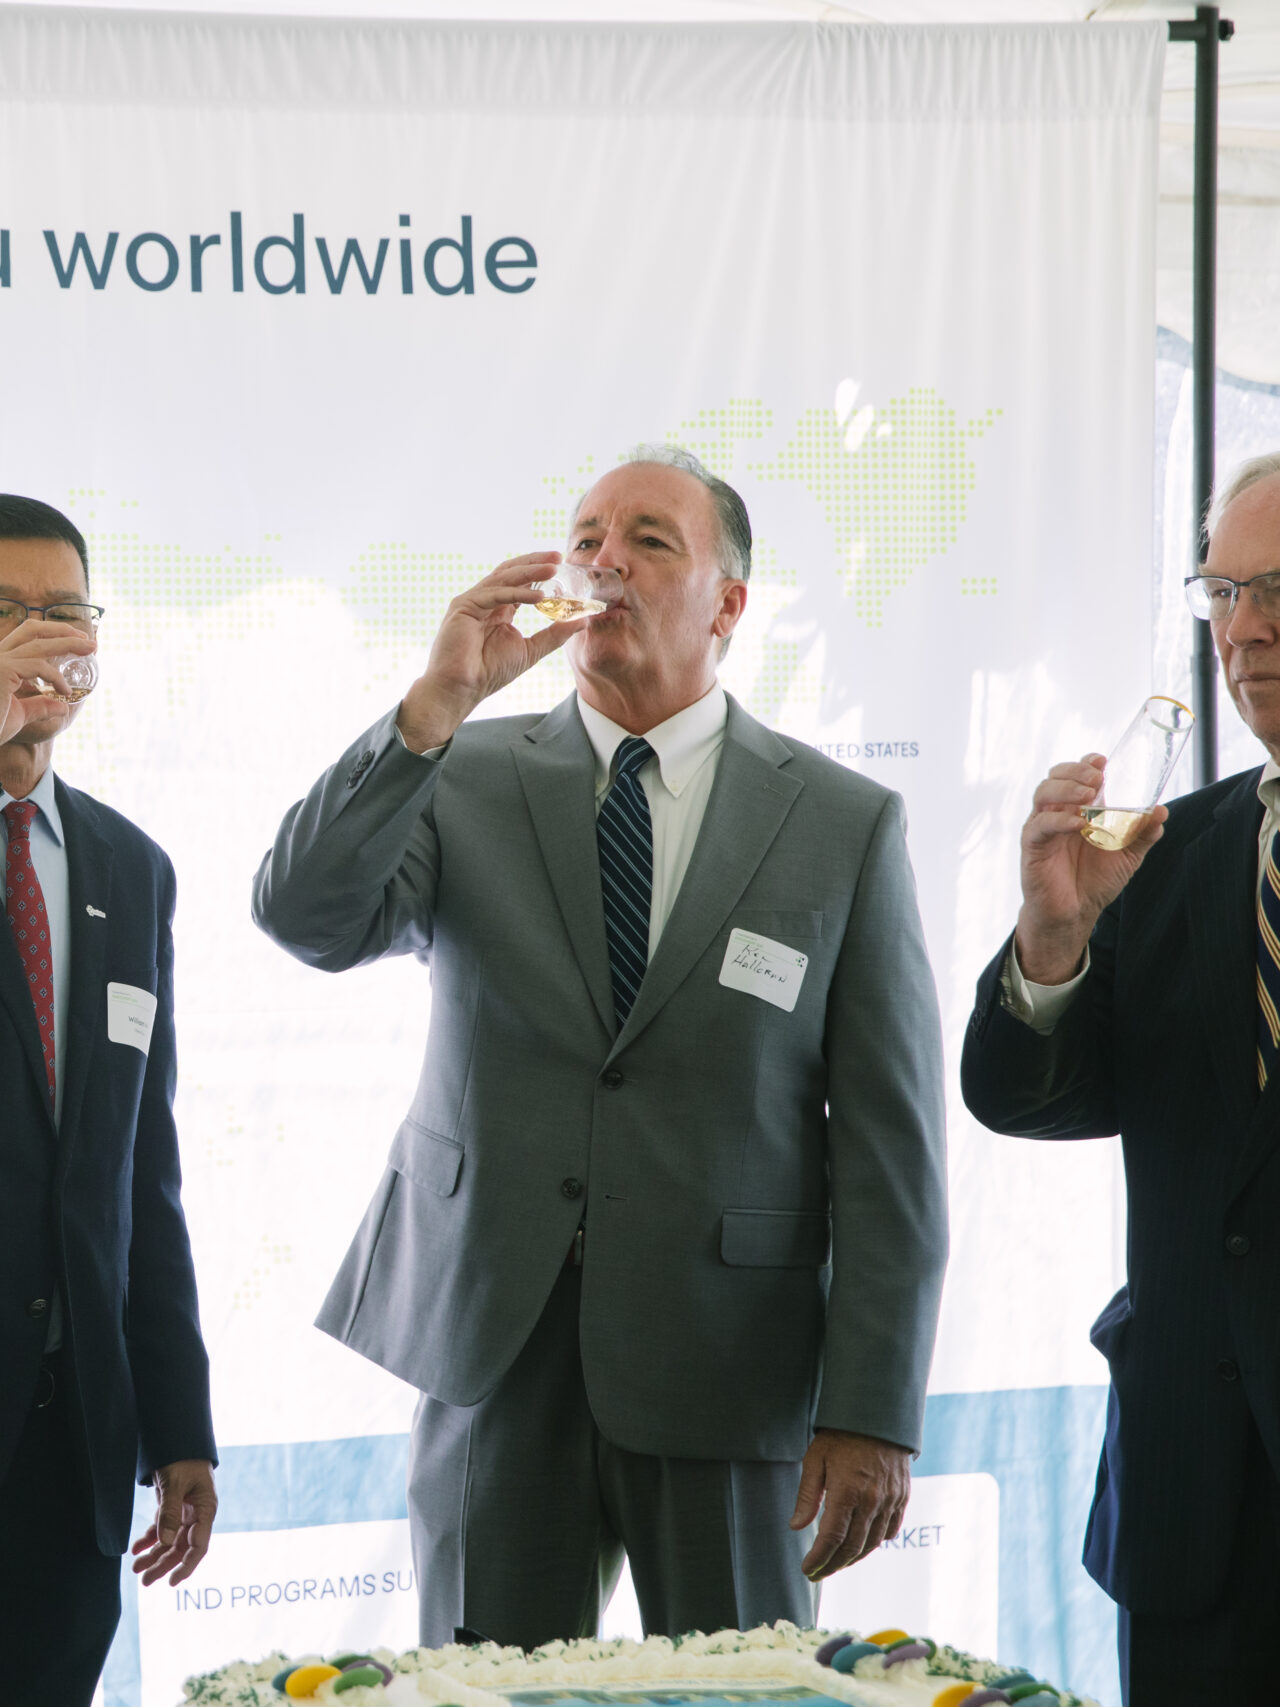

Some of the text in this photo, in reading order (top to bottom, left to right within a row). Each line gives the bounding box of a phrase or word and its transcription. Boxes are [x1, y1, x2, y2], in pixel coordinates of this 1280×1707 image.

[43, 211, 537, 296] worldwide
[814, 741, 920, 758] ITED STATES
[176, 1570, 413, 1611] IND PROGRAMS SU
